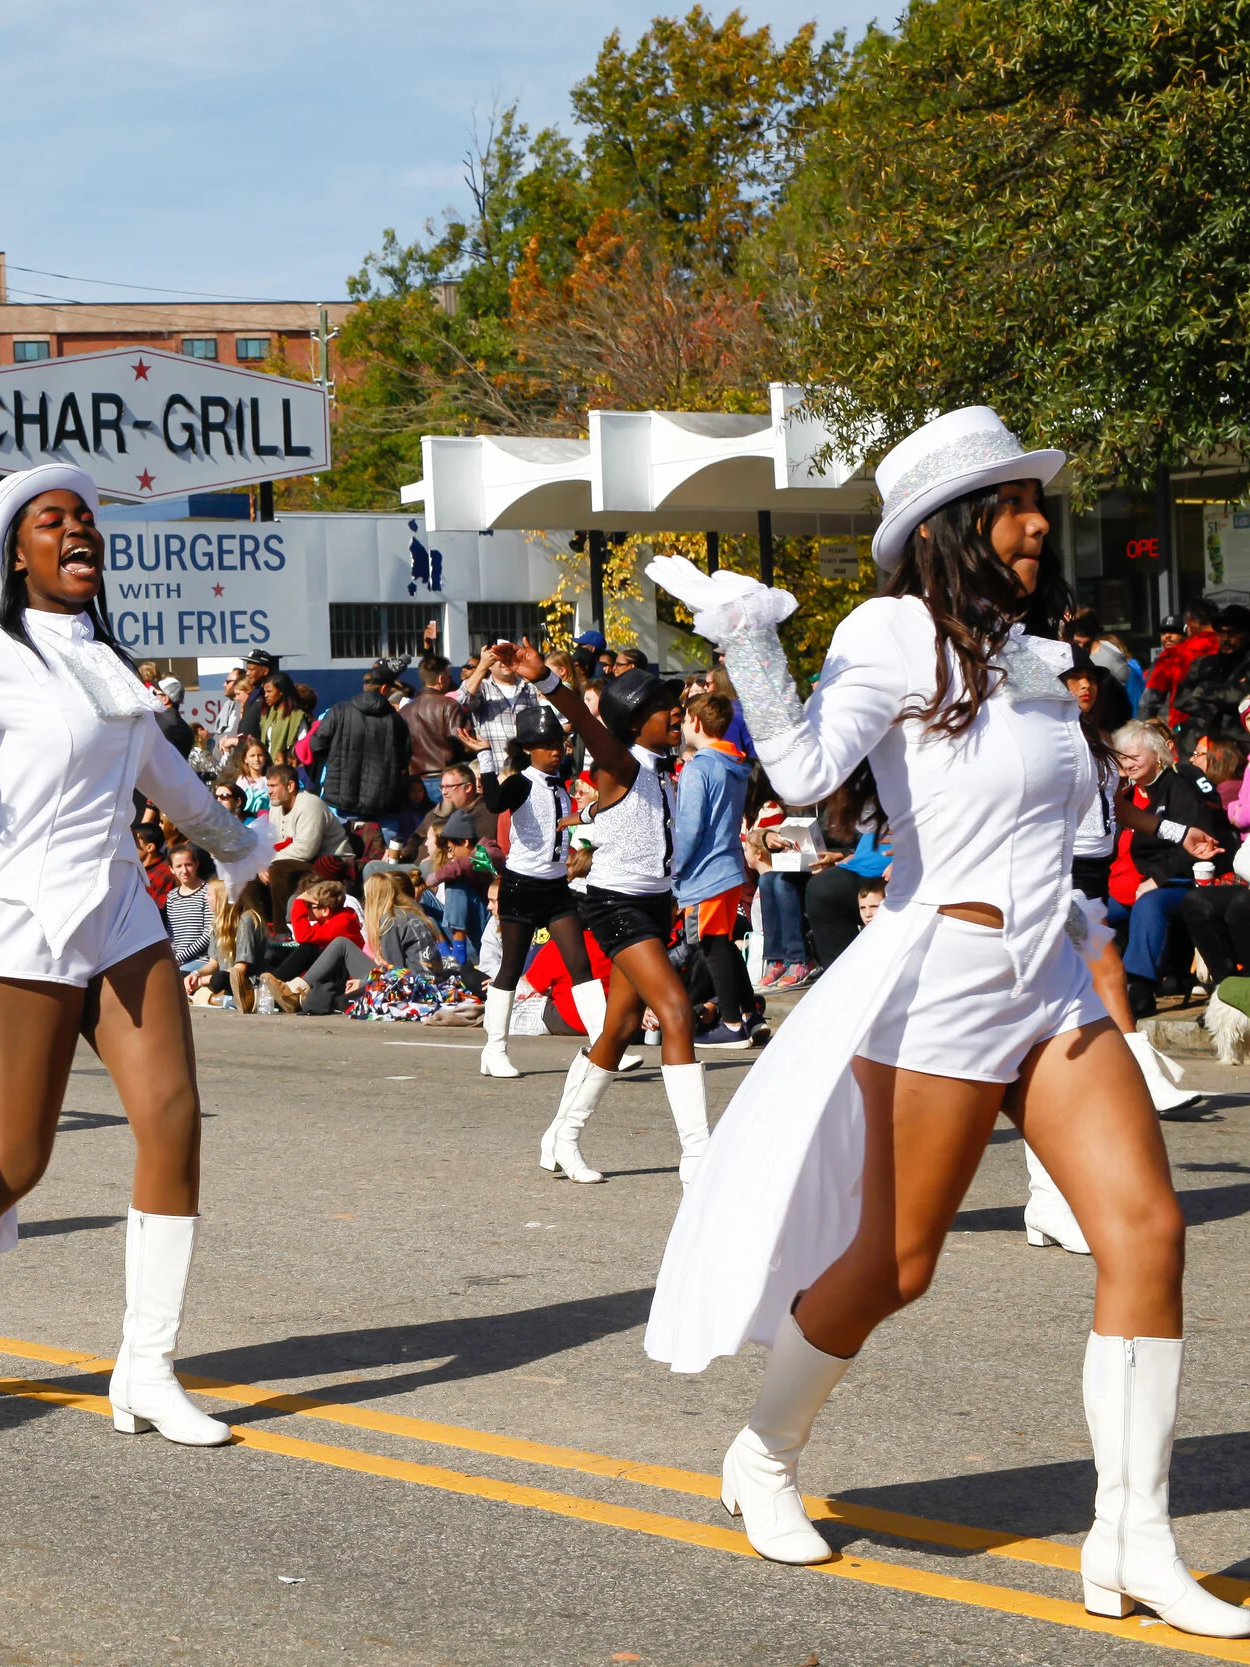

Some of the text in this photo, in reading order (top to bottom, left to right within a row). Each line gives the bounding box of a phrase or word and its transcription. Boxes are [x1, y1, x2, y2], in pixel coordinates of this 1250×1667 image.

[103, 533, 286, 572] BURGERS
[1126, 538, 1159, 559] OPE
[118, 583, 182, 599] WITH
[177, 609, 271, 645] FRIES
